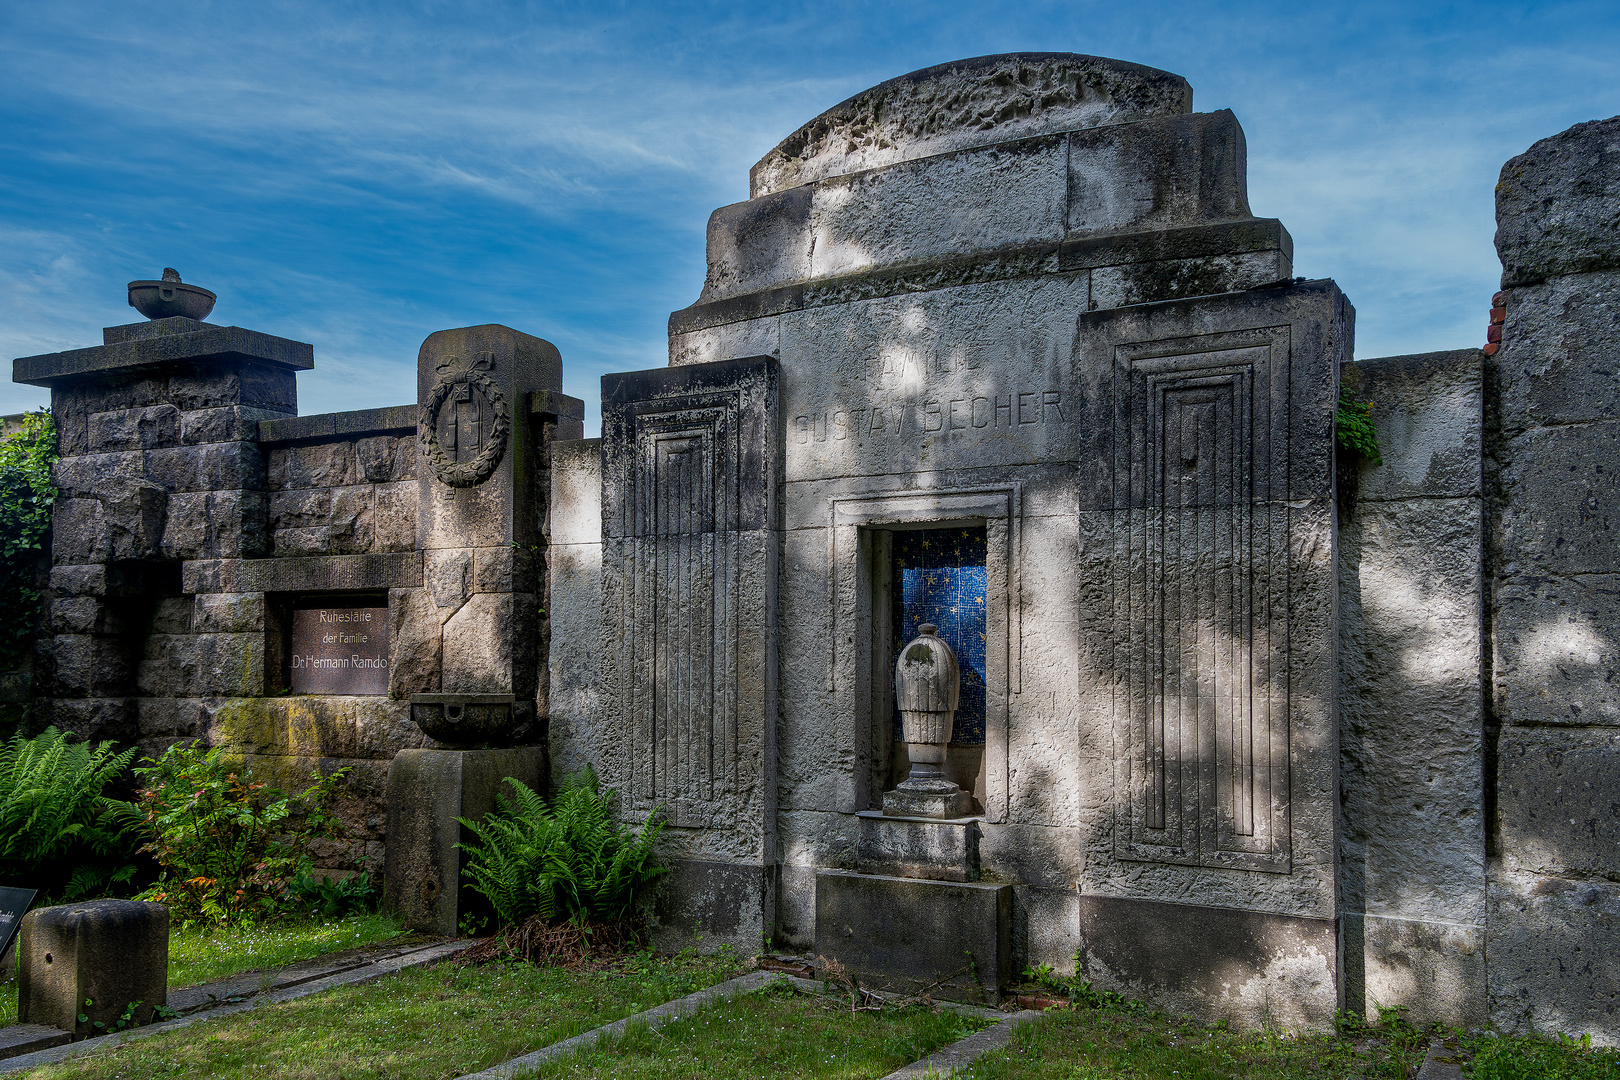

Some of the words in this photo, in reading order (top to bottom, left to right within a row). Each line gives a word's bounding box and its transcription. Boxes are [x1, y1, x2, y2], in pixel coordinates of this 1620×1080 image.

[864, 346, 980, 382] FAMILIE
[795, 404, 905, 445] GUSTAV
[923, 391, 1065, 434] BECHER
[319, 610, 372, 623] Ruhestätte
[322, 632, 337, 643] der
[339, 632, 368, 643] Familie
